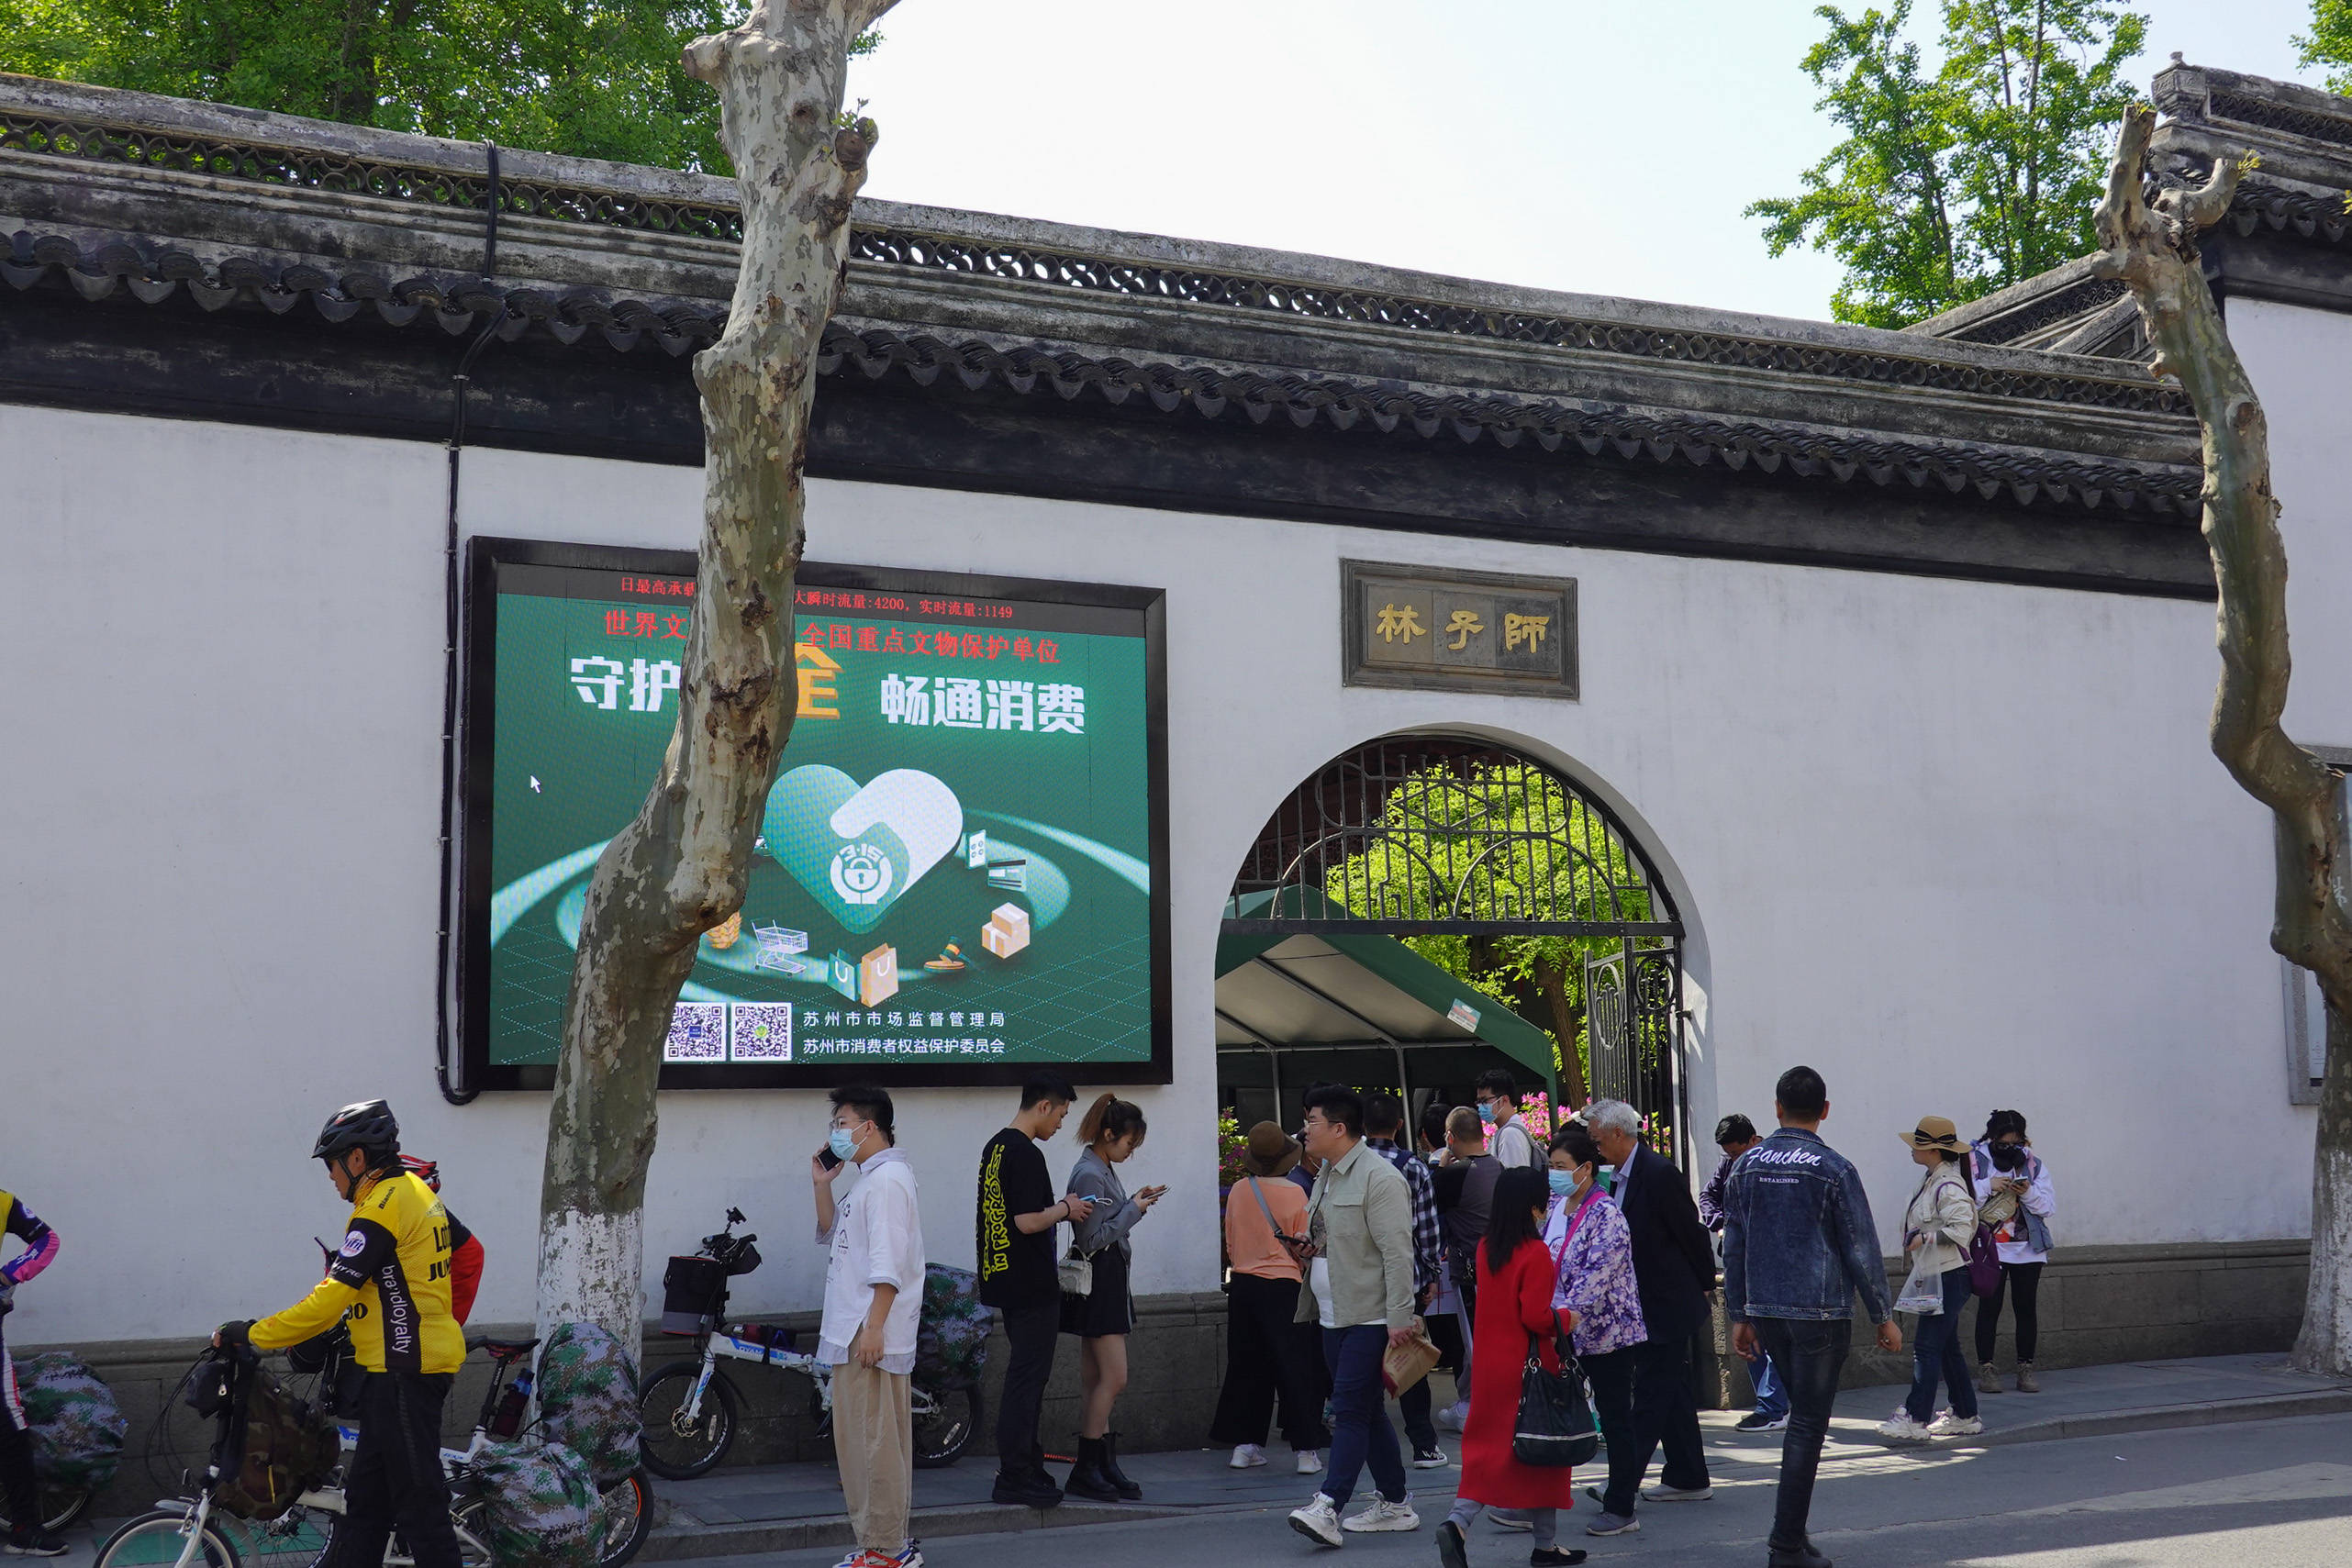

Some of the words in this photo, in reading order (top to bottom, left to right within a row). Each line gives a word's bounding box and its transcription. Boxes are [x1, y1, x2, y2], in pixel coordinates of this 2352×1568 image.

[800, 621, 1061, 663] 全国重点文物保护单位
[880, 673, 1085, 734] 畅通消费
[803, 1011, 1005, 1028] 苏州市市场监督管理局
[803, 1038, 1005, 1055] 苏州市消费者权益保护委员会
